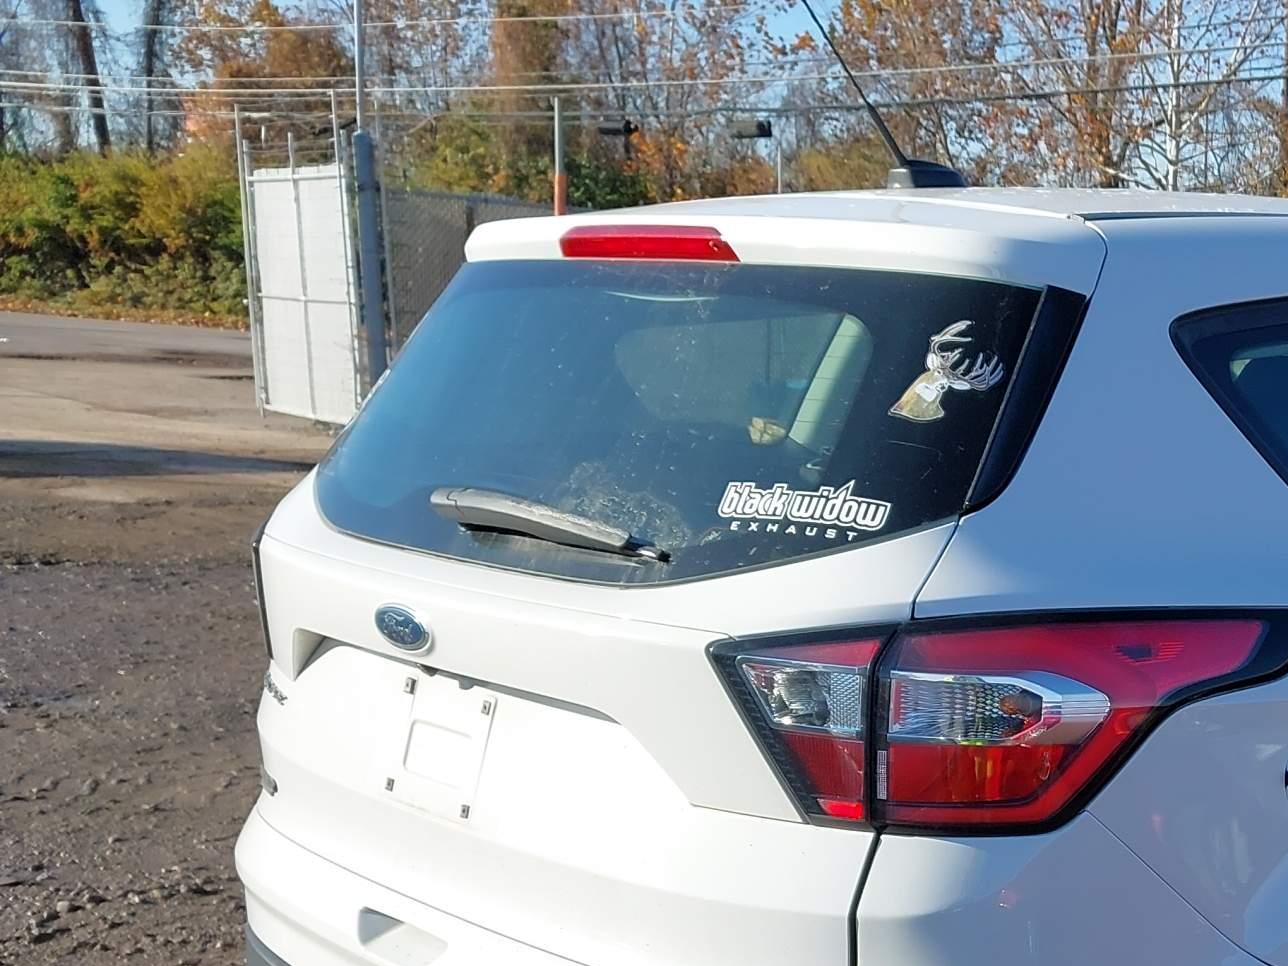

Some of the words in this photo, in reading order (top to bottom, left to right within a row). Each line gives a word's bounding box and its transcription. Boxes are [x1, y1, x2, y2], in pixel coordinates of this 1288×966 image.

[718, 482, 793, 519] black
[787, 480, 891, 531] widow
[730, 521, 858, 541] EXHAUST
